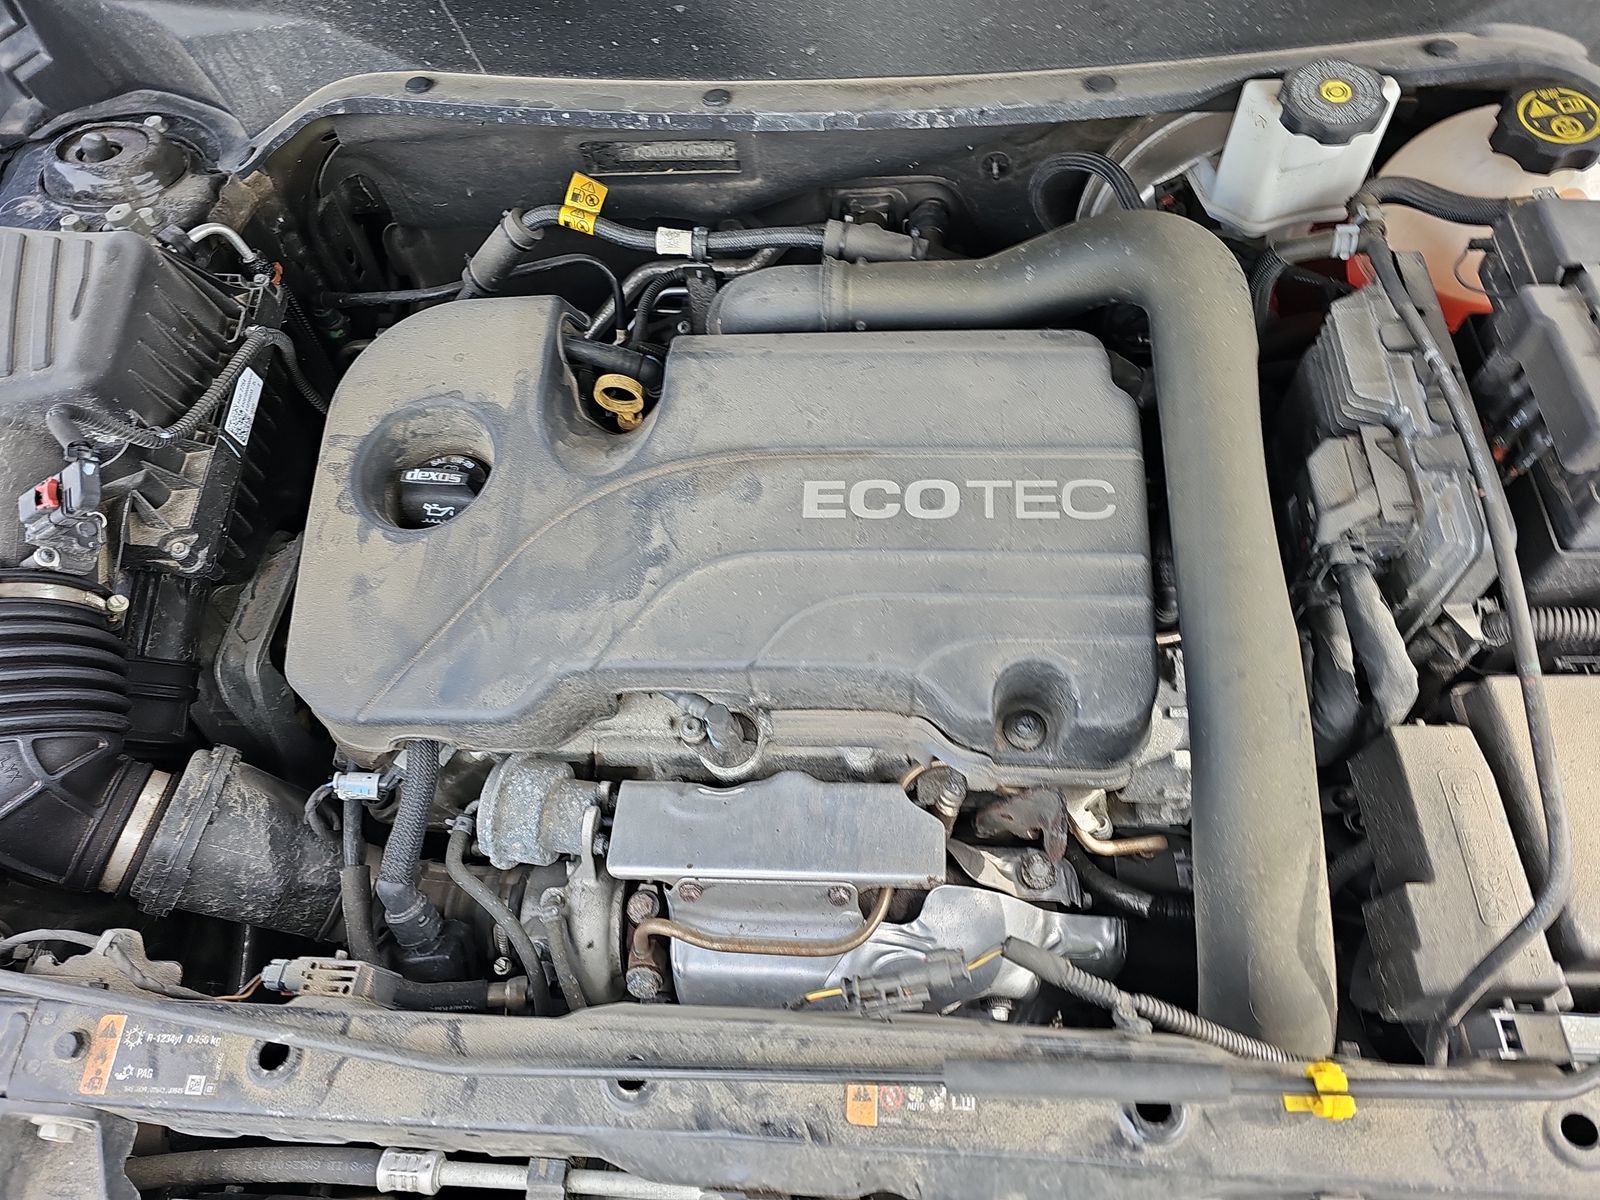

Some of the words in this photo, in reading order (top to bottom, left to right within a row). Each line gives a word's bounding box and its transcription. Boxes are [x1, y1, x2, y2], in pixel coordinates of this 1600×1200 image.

[405, 468, 461, 483] dexos
[802, 479, 1117, 520] ECOTEC
[146, 1033, 184, 1046] R-1234yf
[136, 1068, 154, 1079] PAG
[906, 1102, 925, 1112] AUTO
